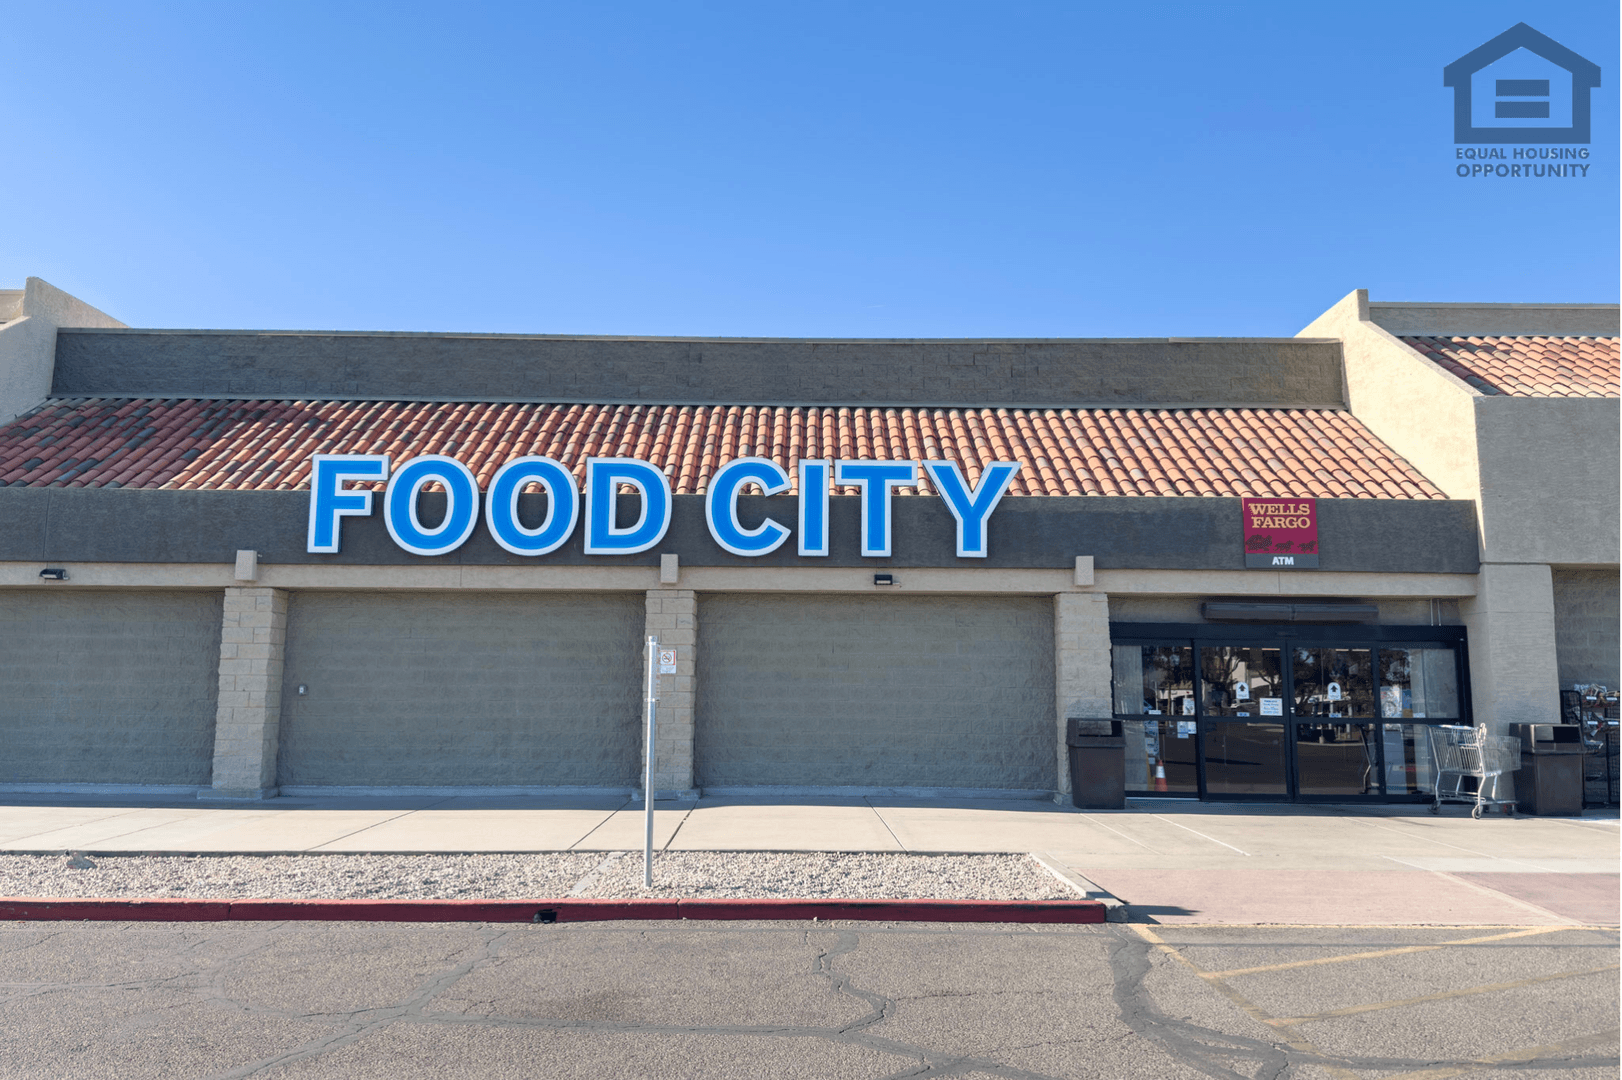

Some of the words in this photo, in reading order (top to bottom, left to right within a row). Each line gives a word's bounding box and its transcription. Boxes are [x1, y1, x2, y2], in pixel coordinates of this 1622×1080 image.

[306, 454, 673, 556] FOOD
[705, 456, 1022, 558] CITY
[1248, 503, 1311, 516] WELLS
[1251, 516, 1311, 529] FARGO
[1271, 556, 1295, 566] ATM
